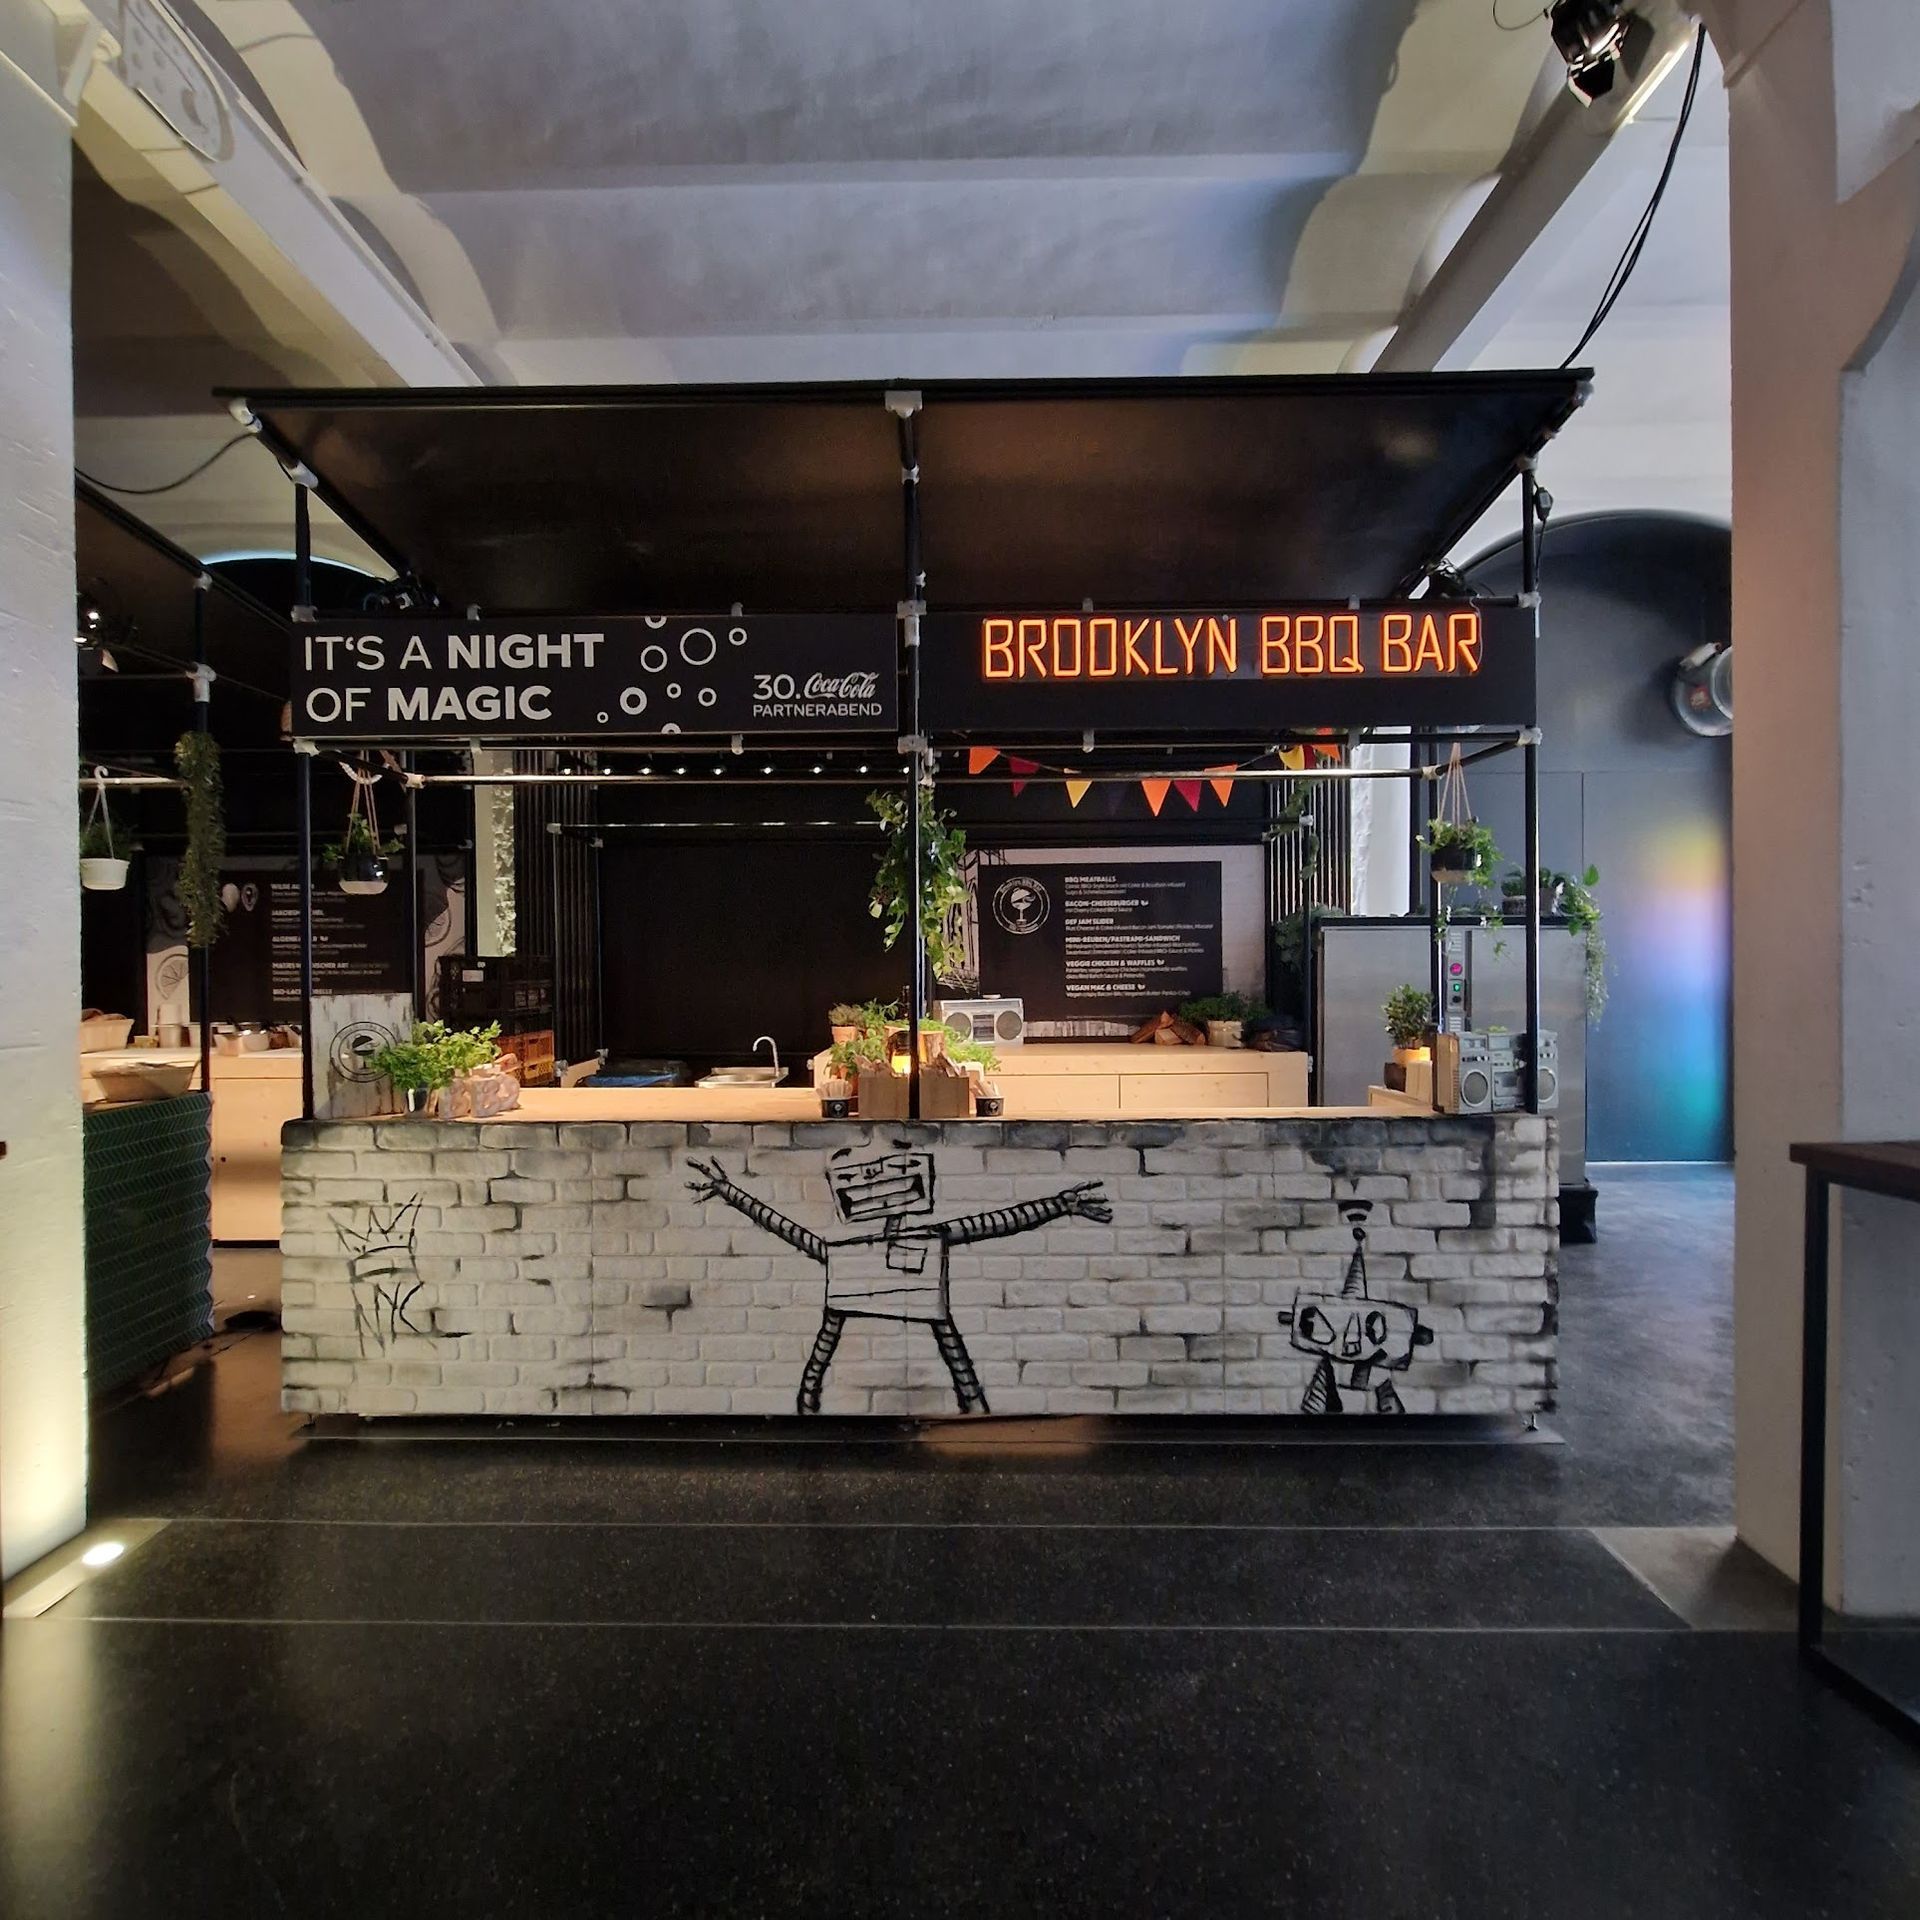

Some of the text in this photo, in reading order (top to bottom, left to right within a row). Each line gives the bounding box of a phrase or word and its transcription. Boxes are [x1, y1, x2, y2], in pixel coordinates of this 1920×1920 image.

[400, 635, 432, 669] A
[448, 634, 604, 669] NIGHT
[984, 614, 1479, 678] BROOKLYN BBQ BAR
[306, 685, 552, 722] OF MAGIC
[753, 674, 801, 700] 30.
[753, 703, 882, 717] PARTNERABEND
[1064, 899, 1139, 907] BACON-CHEESEBURGER
[351, 1281, 426, 1357] NYC
